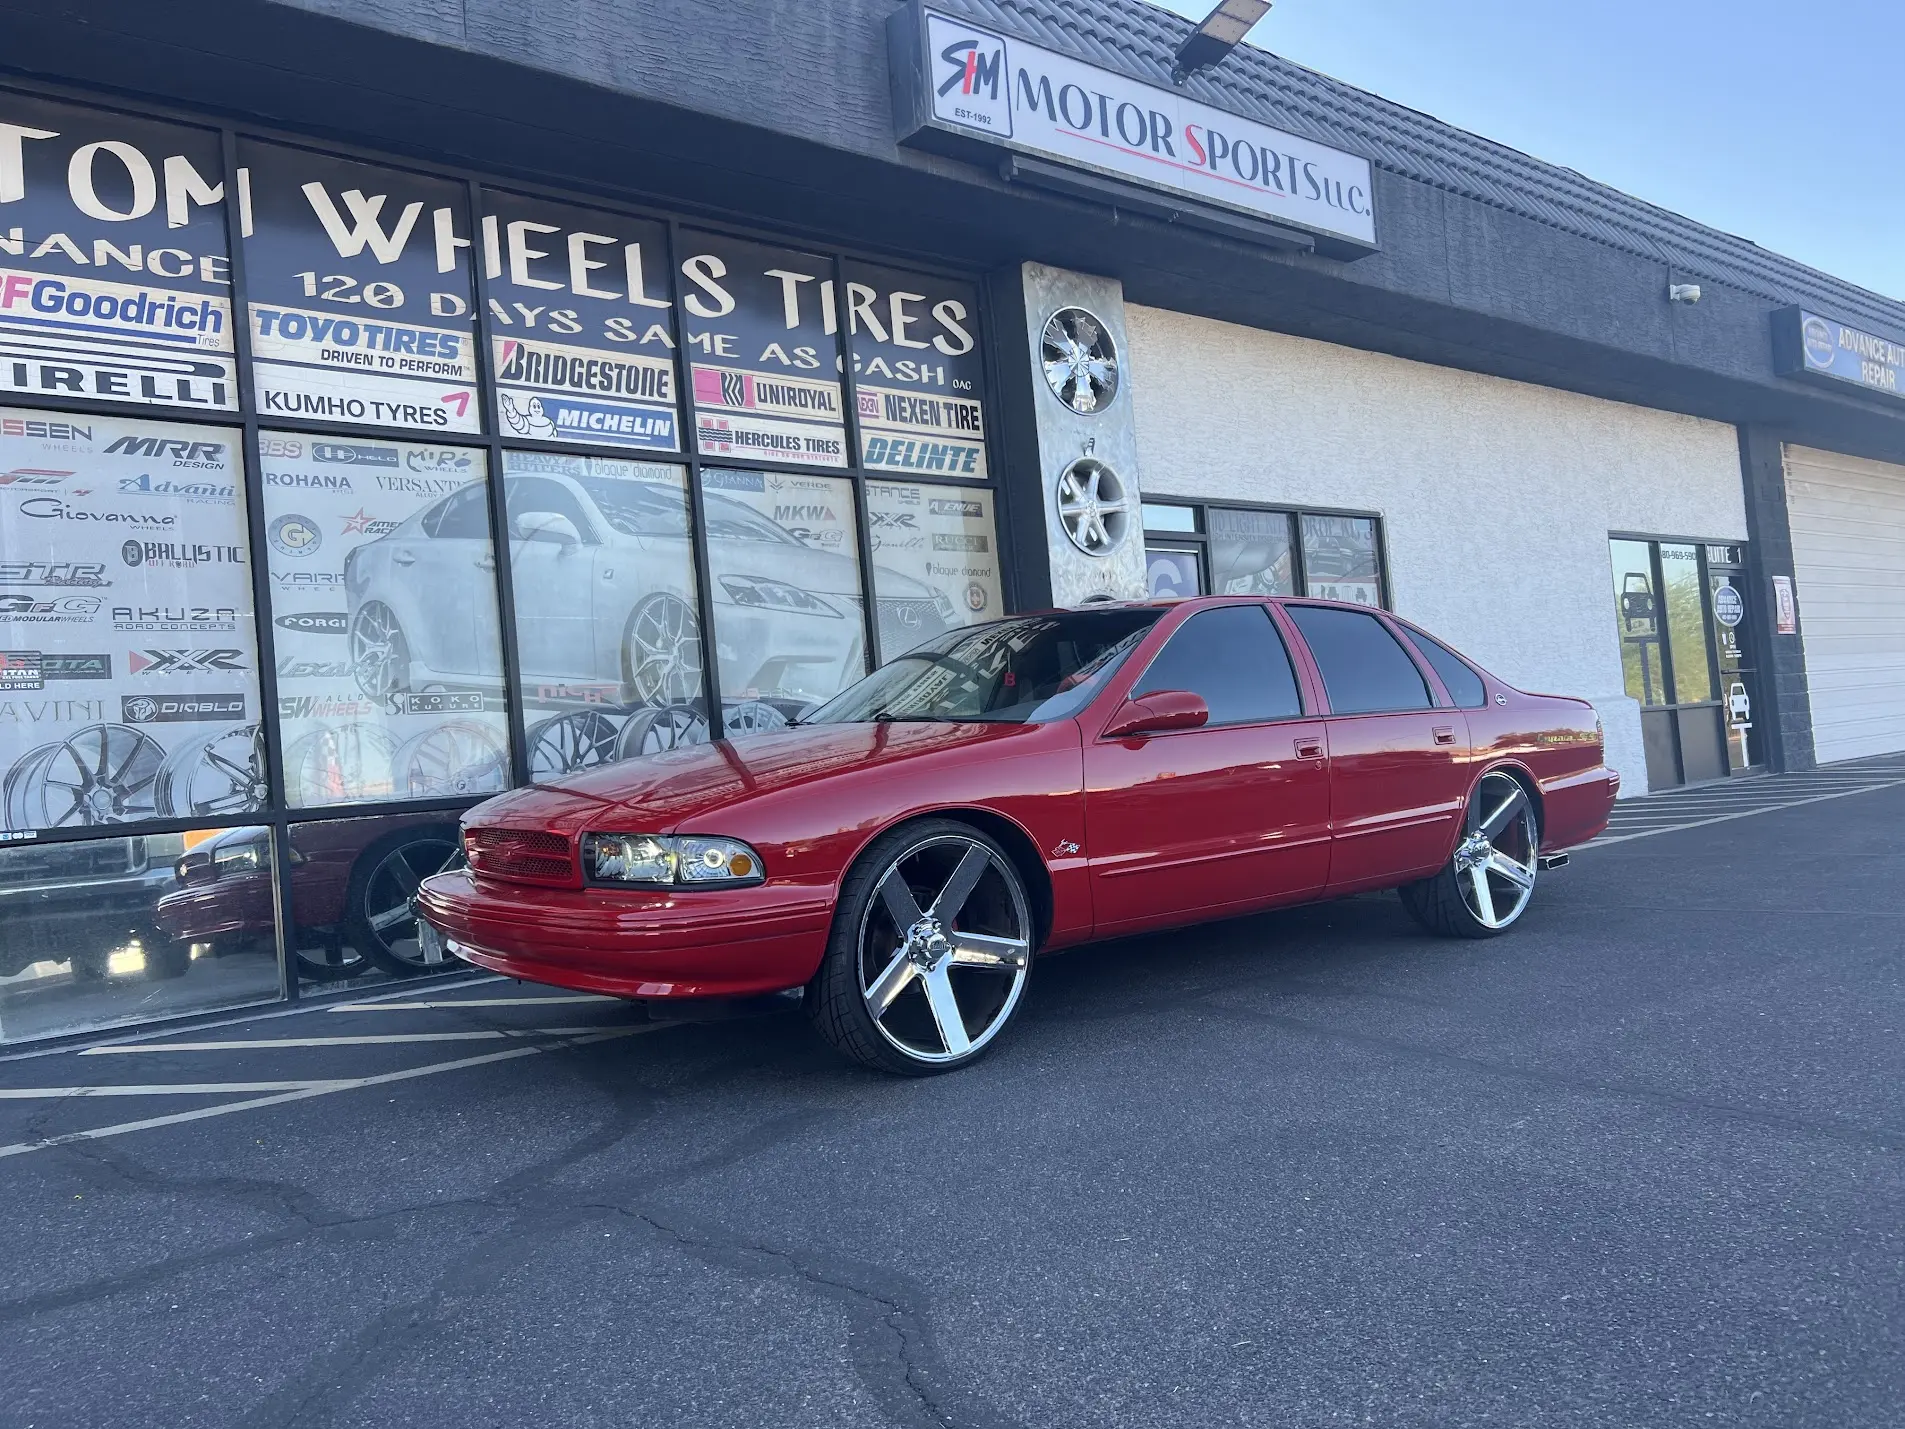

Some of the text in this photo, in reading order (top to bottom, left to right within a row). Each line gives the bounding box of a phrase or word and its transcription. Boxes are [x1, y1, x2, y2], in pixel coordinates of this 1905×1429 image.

[955, 108, 992, 125] EST-1992
[1017, 67, 1175, 157] MOTOR
[1185, 124, 1321, 201] SPORTS
[301, 181, 736, 318] WHEELS
[763, 269, 975, 356] TIRES
[0, 275, 223, 334] FGoodrich
[197, 333, 220, 348] Tires
[292, 271, 405, 309] 120
[430, 293, 583, 334] DAYS
[603, 317, 740, 358] SAME
[759, 343, 821, 369] AS
[836, 352, 944, 386] CASH
[952, 379, 972, 391] OAC
[1838, 327, 1885, 362] ADVANCE
[321, 349, 463, 377] DRIVEN TO PERFORM
[500, 340, 669, 399] BRIDGESTONE
[1862, 361, 1896, 391] REPAIR
[756, 382, 837, 413] UNIROYAL
[264, 390, 448, 426] KUMHO TYRES
[884, 393, 941, 427] NEXEN
[942, 402, 980, 431] TIRE
[0, 419, 92, 441] SSEN
[556, 409, 671, 437] MICHELIN
[42, 443, 94, 453] WHEELS
[103, 436, 226, 462] MRR
[735, 430, 840, 455] HERCULES TIRES
[357, 454, 397, 462] HELO
[864, 437, 980, 473] DELINTE
[173, 460, 225, 470] DESIGN
[633, 463, 672, 480] diamond
[119, 474, 236, 496] Advanti
[265, 472, 352, 488] ROHANA
[790, 480, 832, 489] VERDE
[186, 498, 236, 506] RACING
[865, 486, 920, 500] STANCE
[20, 497, 176, 525] Giovanna
[773, 505, 825, 521] MKW
[935, 535, 978, 546] RUCCI
[143, 541, 246, 565] BALLISTIC
[933, 563, 991, 578] blaque diamond
[112, 607, 236, 621] AKUZA
[284, 617, 346, 628] FORGI
[161, 701, 243, 713] DIABLO
[313, 701, 373, 717] WHEELS
[411, 695, 480, 704] KOKO
[411, 703, 480, 711] KUTURE
